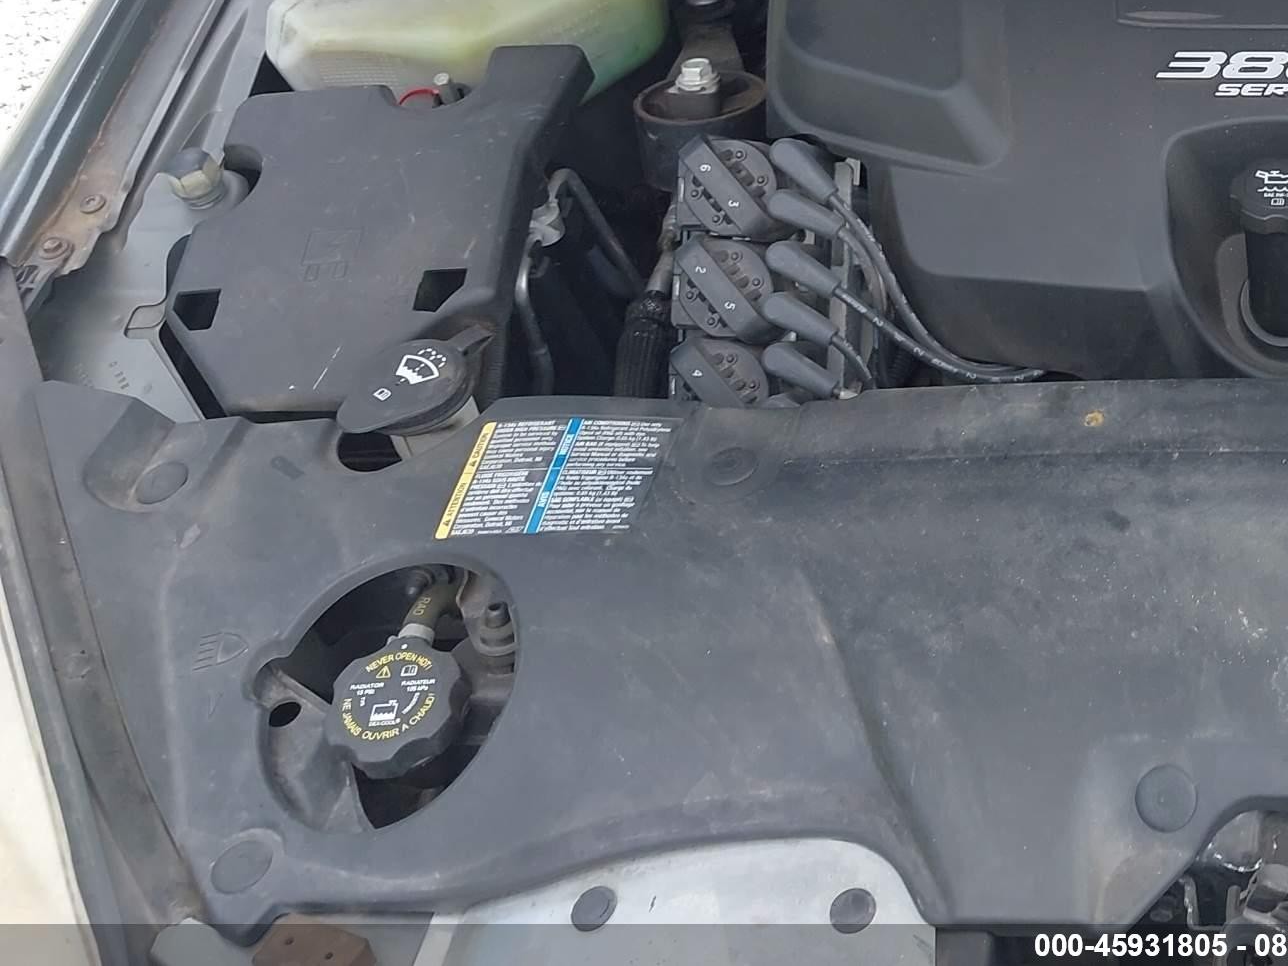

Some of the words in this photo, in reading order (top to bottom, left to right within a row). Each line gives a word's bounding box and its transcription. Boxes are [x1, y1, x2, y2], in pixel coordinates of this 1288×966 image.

[472, 433, 489, 459] CAUTION
[447, 482, 467, 516] ATTENTION
[412, 596, 432, 615] RAD
[365, 654, 395, 673] NEVER
[395, 651, 417, 662] OPEN
[416, 656, 433, 671] HOT!
[350, 682, 385, 690] RADIATOR
[401, 678, 436, 686] RADIATEUR
[342, 698, 353, 712] NE
[409, 693, 436, 725] CHAUD!
[342, 712, 362, 736] JAMAIS
[362, 728, 400, 740] OUVRIR
